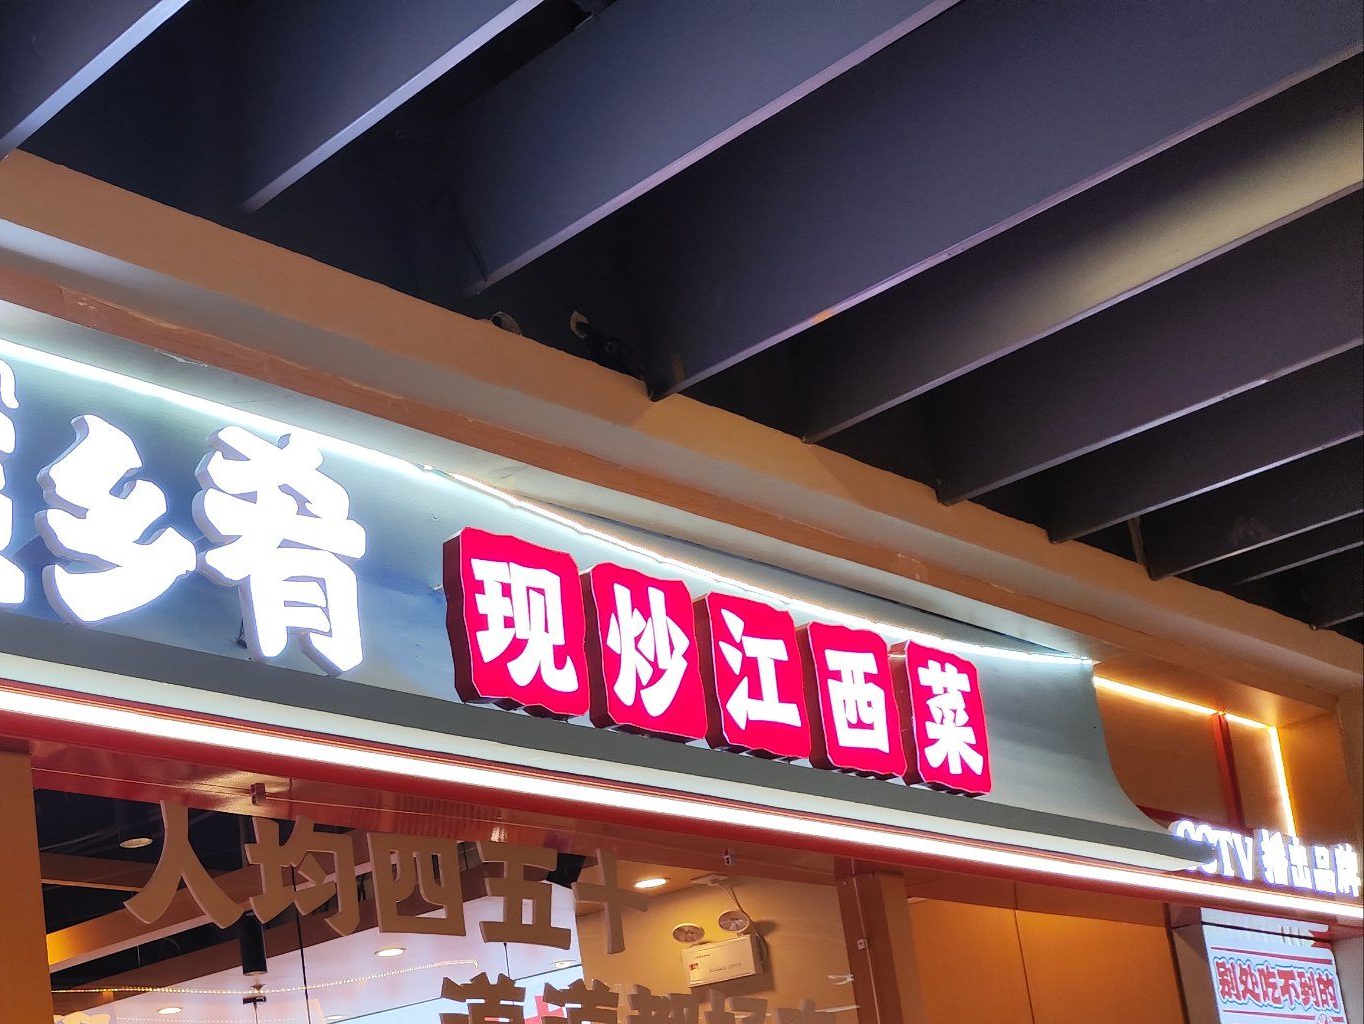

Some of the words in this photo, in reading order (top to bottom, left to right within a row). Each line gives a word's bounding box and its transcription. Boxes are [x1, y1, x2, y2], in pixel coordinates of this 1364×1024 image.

[469, 557, 984, 776] 现炒江西菜
[125, 801, 648, 955] 人均四五十
[1216, 959, 1339, 1011] 别处吃不到的
